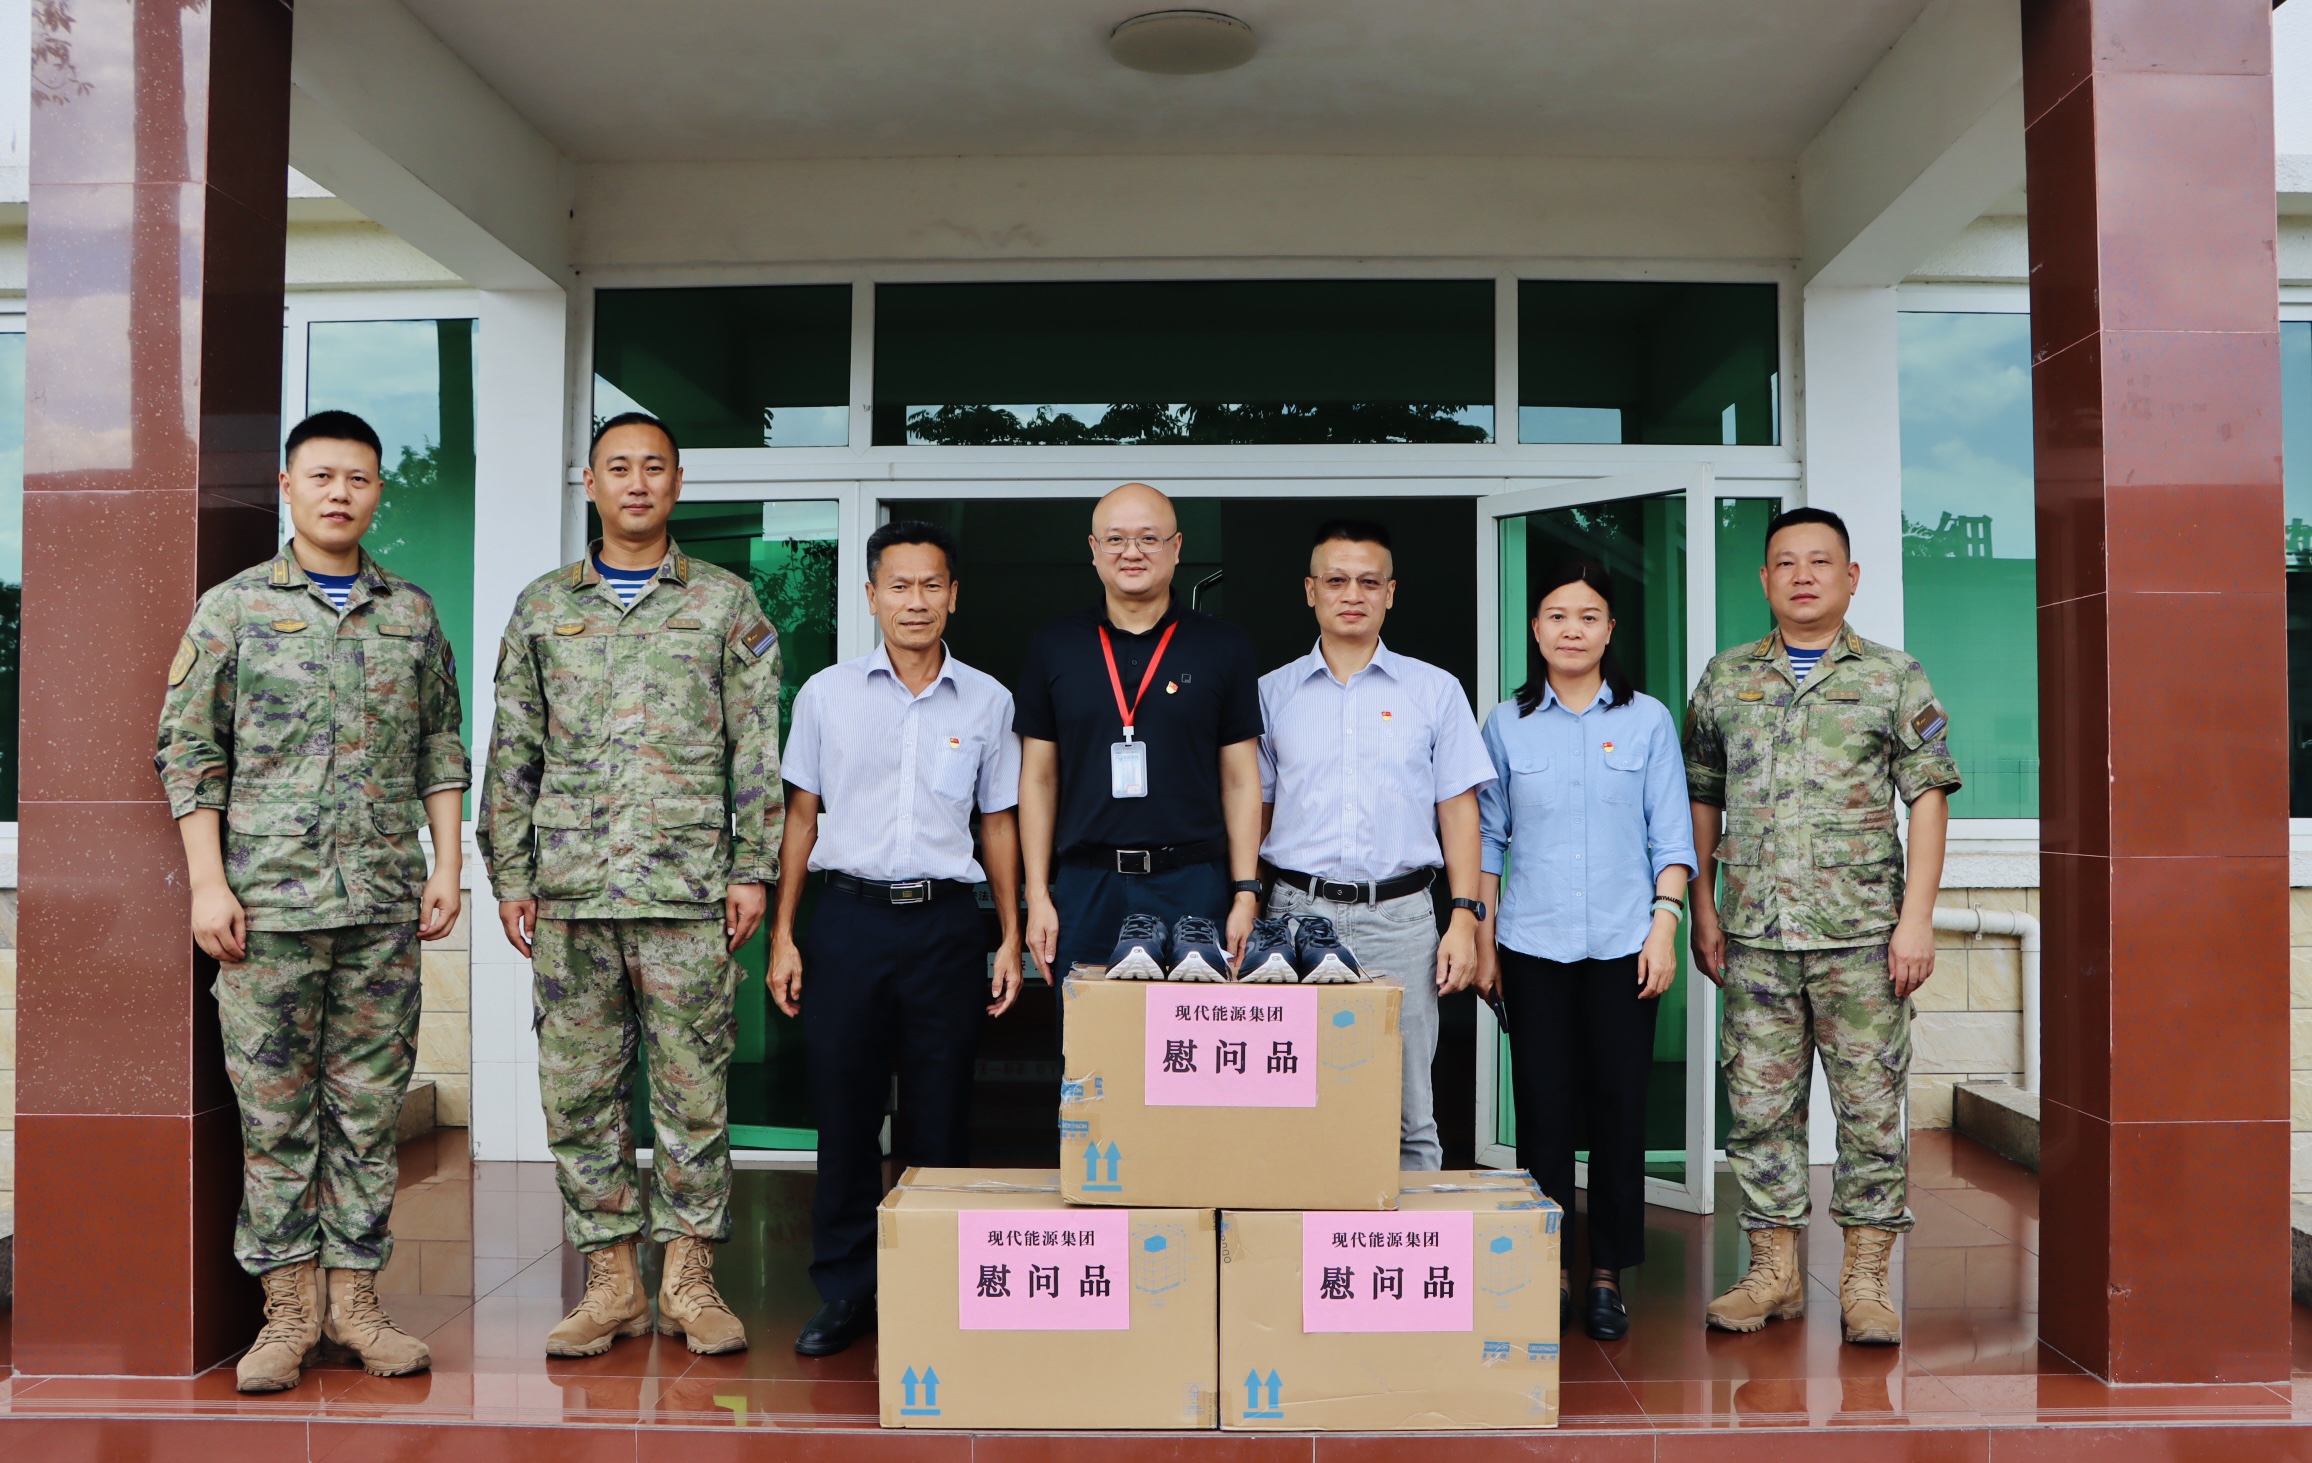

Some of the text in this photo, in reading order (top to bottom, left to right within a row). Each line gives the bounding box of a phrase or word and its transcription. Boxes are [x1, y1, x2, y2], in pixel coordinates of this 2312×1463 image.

[1175, 1004, 1283, 1022] 现代能源集团
[1162, 1038, 1299, 1075] 慰问品
[987, 1230, 1095, 1248] 现代能源集团
[1331, 1231, 1439, 1249] 现代能源集团
[976, 1263, 1111, 1299] 慰问品
[1319, 1265, 1455, 1301] 慰问品
